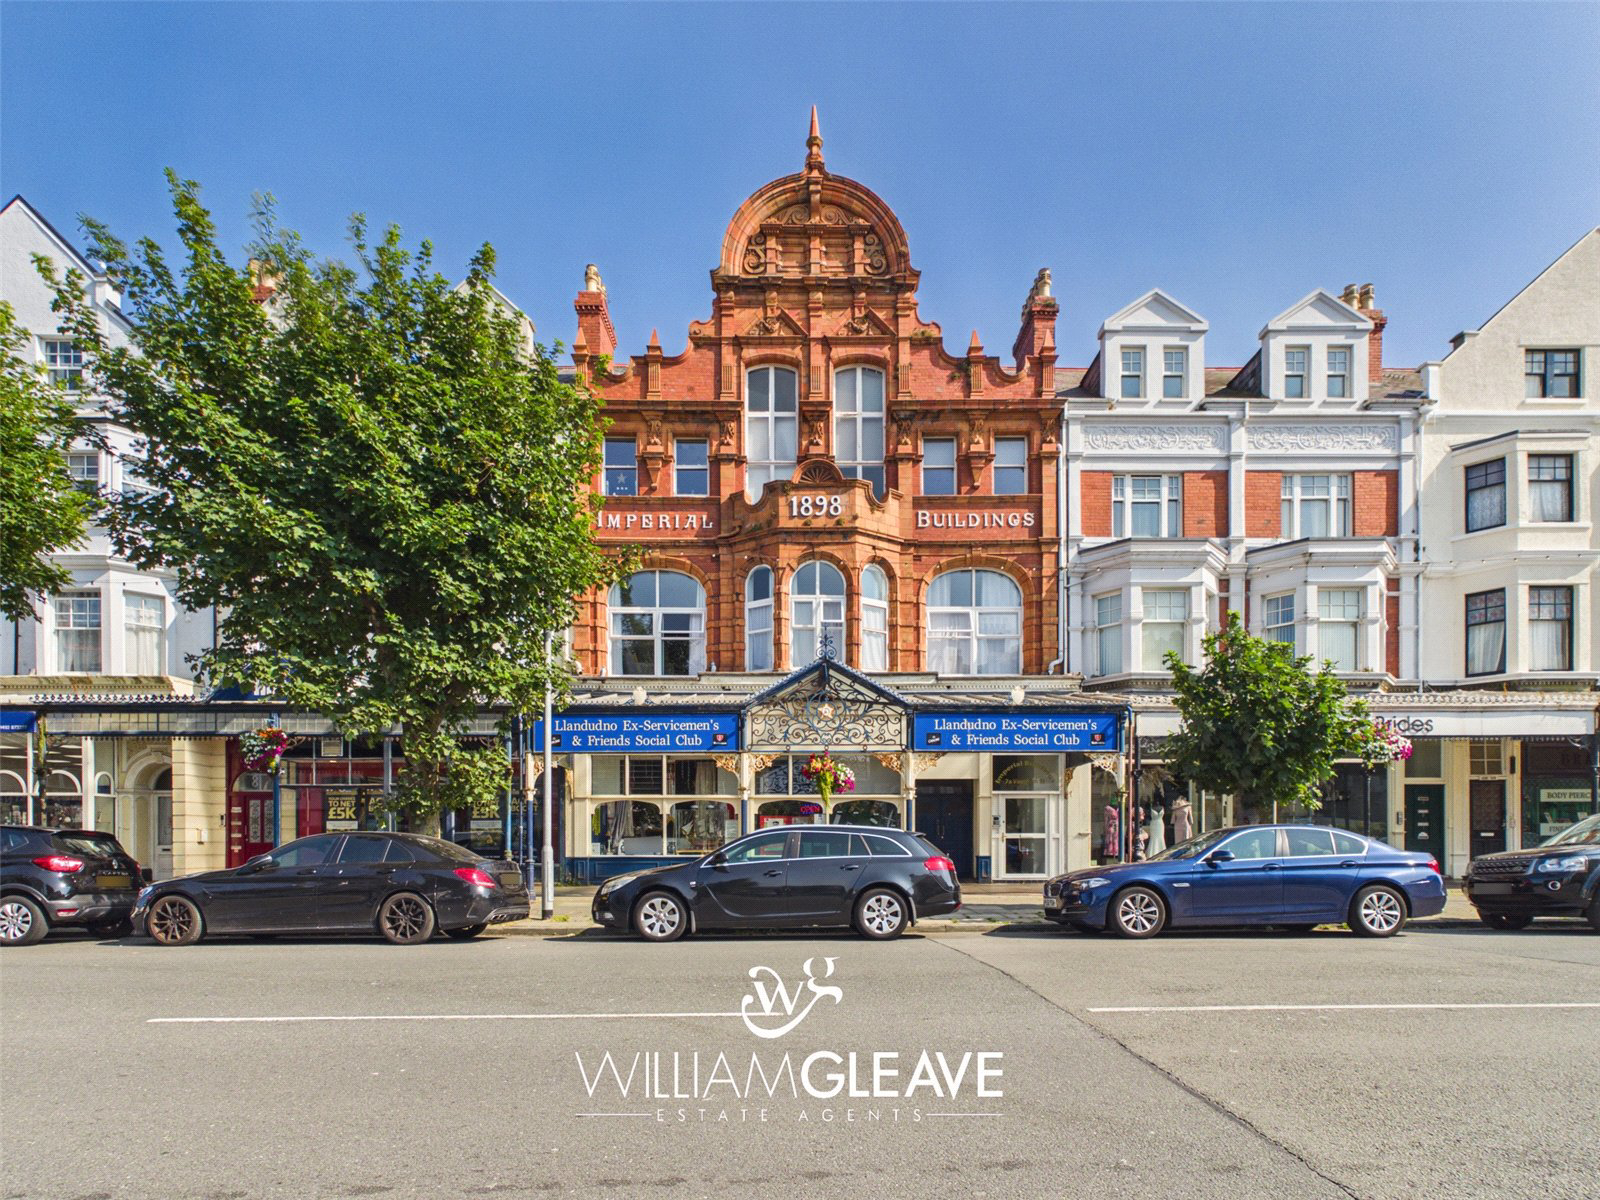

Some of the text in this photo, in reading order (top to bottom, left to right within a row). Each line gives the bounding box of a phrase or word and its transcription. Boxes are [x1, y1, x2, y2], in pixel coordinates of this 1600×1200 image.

[791, 495, 843, 516] 1898
[597, 511, 1035, 528] IMPERIAL BUILDINGS
[555, 719, 719, 731] Llandudno Ex-Servicemen's
[934, 719, 1097, 730] Llandudno Ex-Servicemen's
[572, 735, 582, 746] &
[588, 734, 630, 746] Friends
[635, 735, 670, 746] Social
[675, 735, 702, 746] Club
[951, 734, 961, 745] &
[966, 733, 1009, 745] Friends
[1014, 734, 1048, 745] Social
[1054, 734, 1080, 745] Club
[1547, 791, 1568, 799] BODY
[328, 807, 356, 819] £5K
